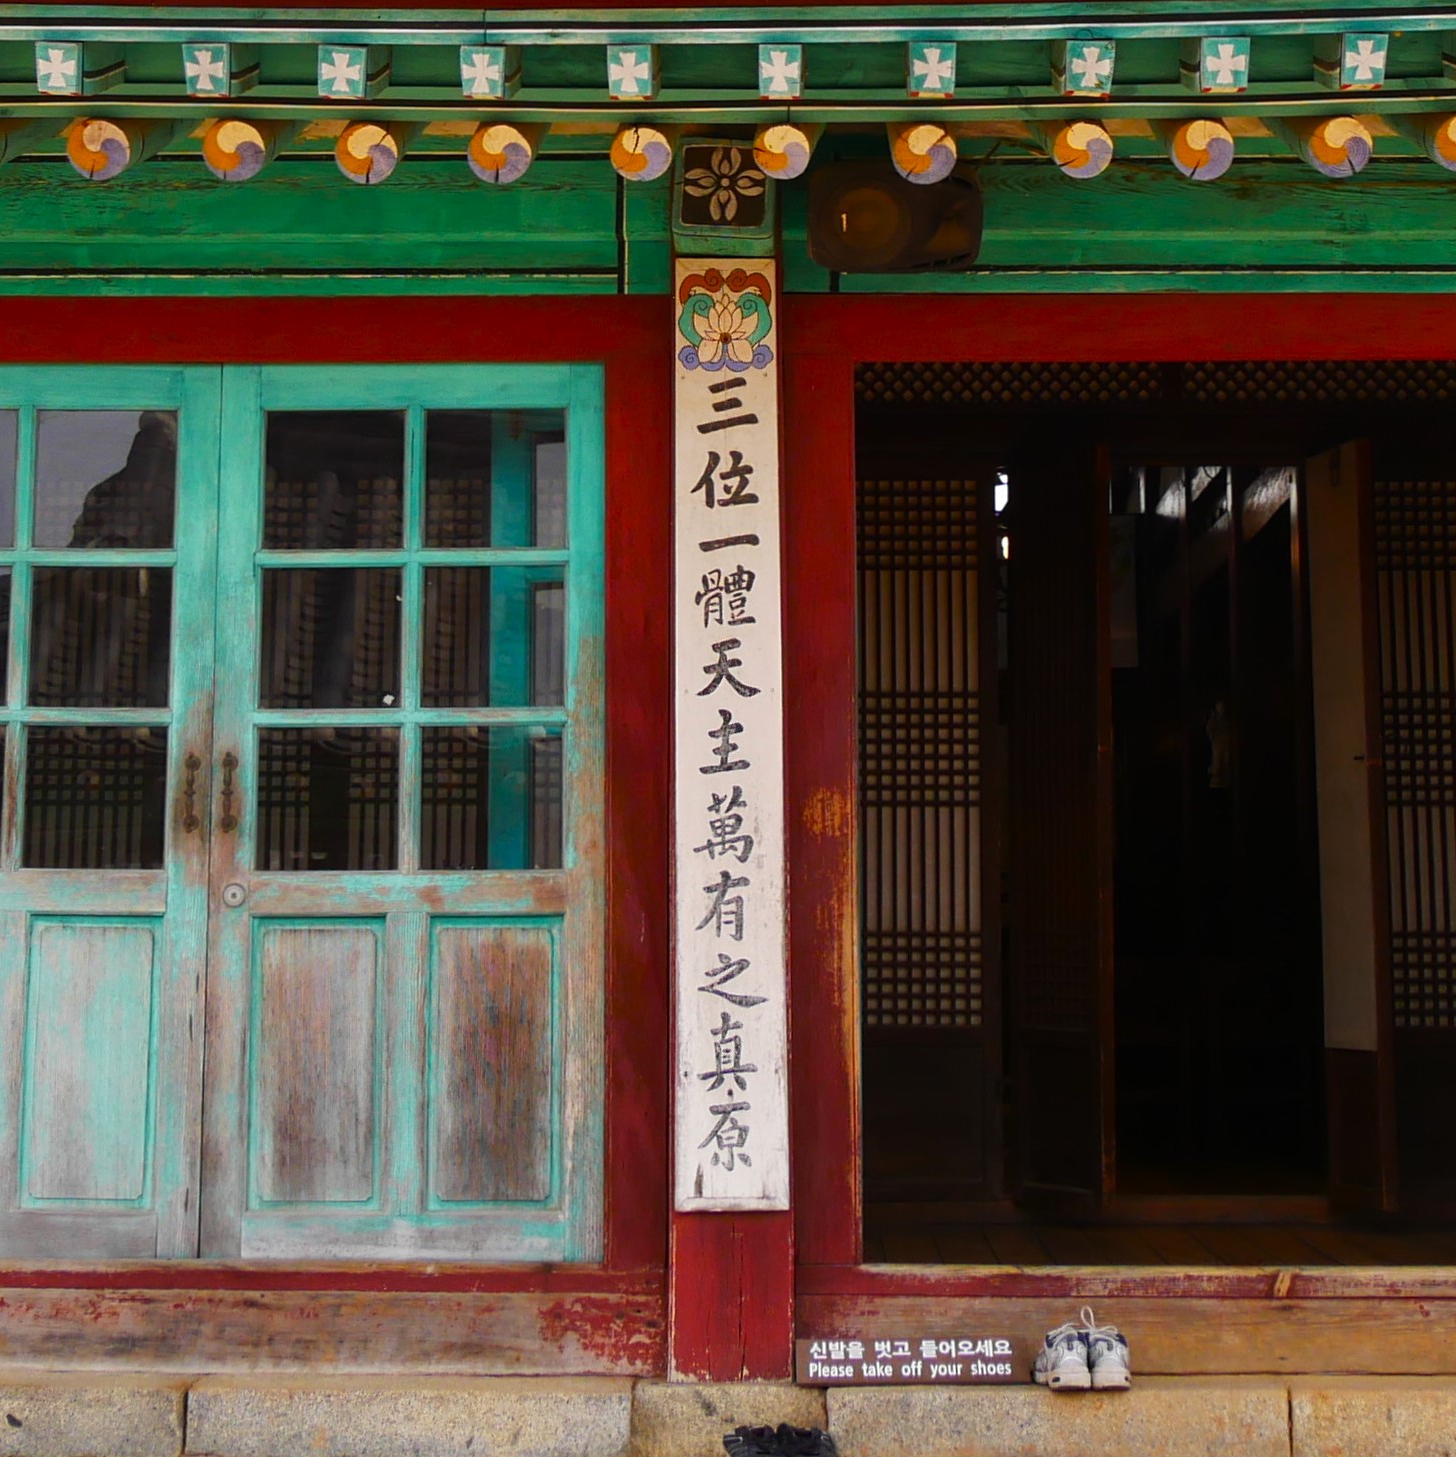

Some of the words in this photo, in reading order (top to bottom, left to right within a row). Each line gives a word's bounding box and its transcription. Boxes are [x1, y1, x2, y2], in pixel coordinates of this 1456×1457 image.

[809, 1340, 865, 1360] 신발을
[874, 1340, 911, 1358] 벗고
[919, 1339, 1013, 1358] 들어오세요
[809, 1360, 854, 1378] Please
[862, 1360, 893, 1377] take
[901, 1359, 923, 1377] off
[930, 1362, 963, 1379] your
[970, 1359, 1012, 1376] shoes
